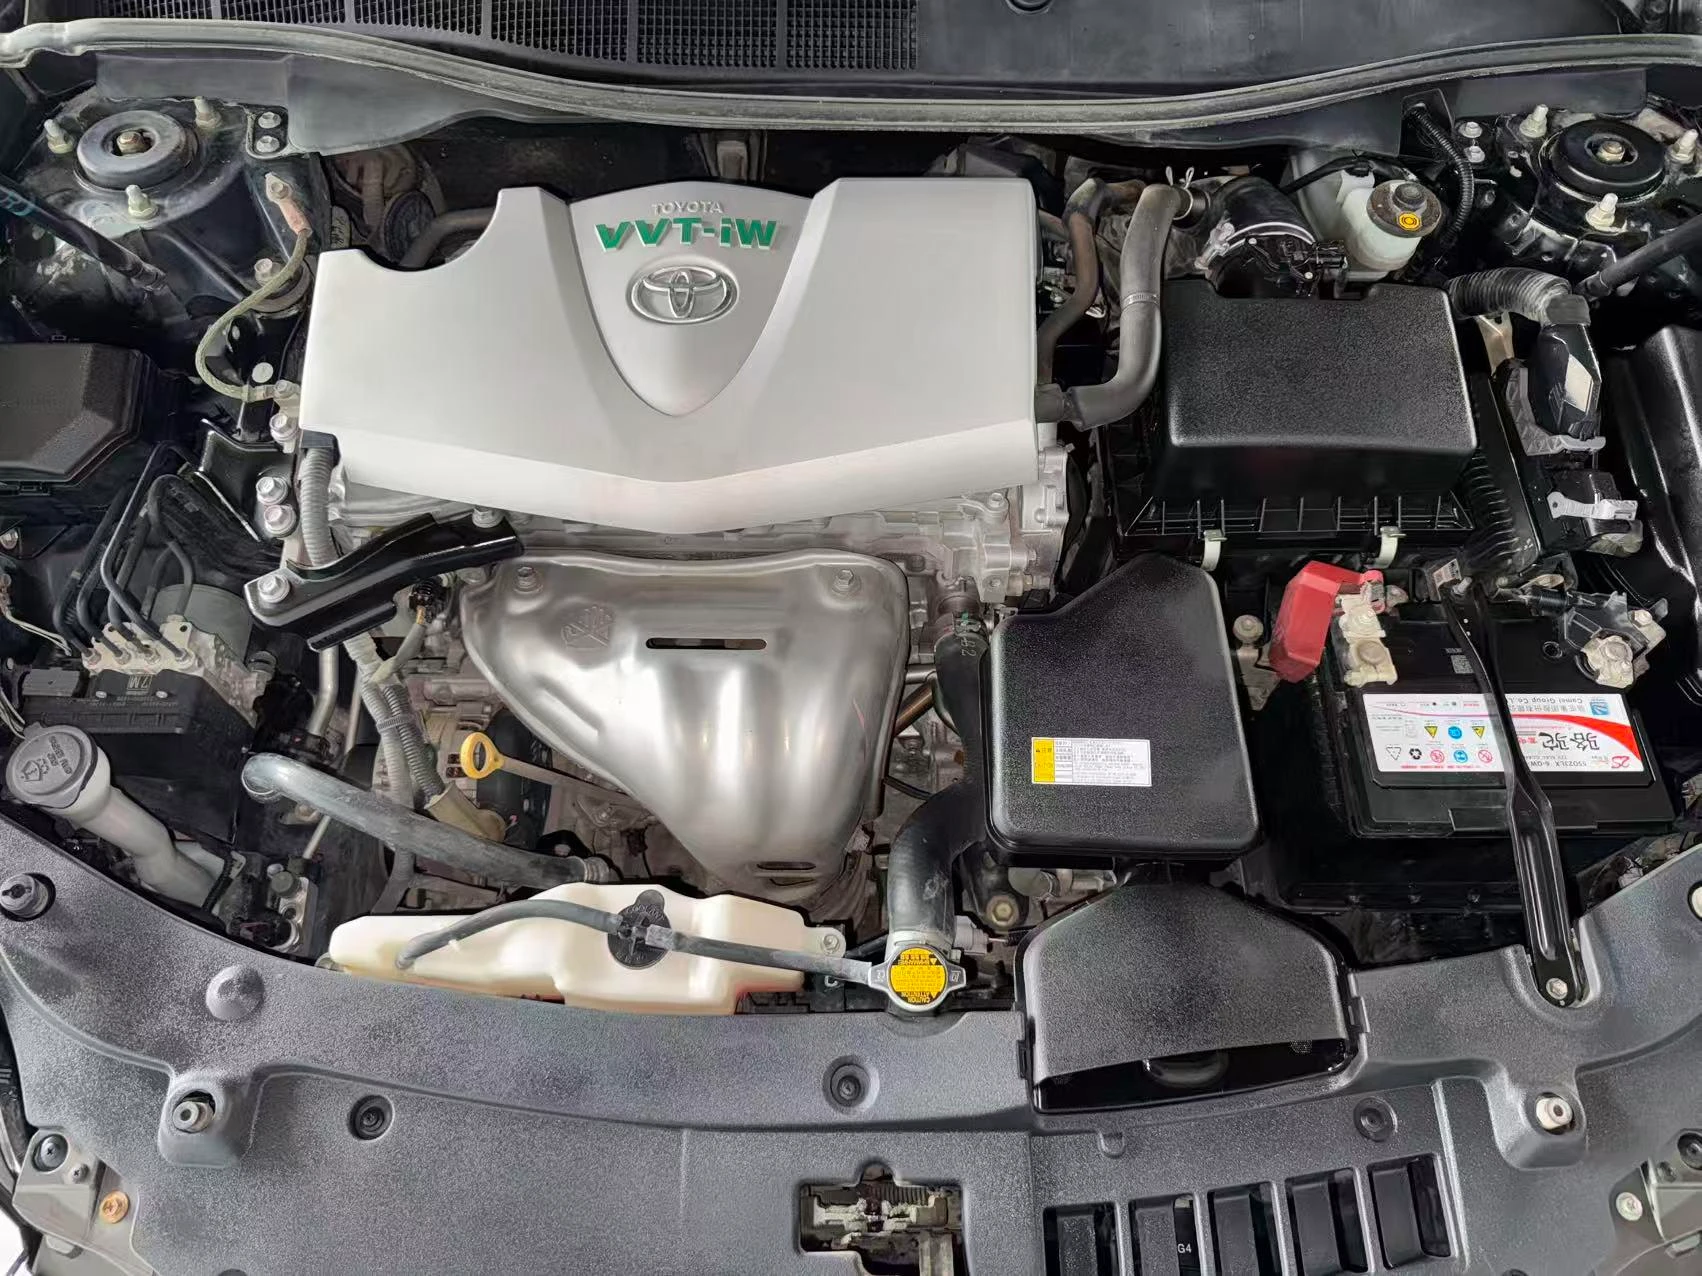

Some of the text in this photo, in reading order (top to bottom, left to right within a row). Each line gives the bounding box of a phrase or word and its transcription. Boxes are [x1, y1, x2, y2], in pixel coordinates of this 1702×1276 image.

[652, 200, 723, 215] TOYOTA
[595, 217, 778, 251] VVT-iW
[1538, 732, 1600, 751] 骆驼
[907, 996, 931, 1004] CAUTION
[1177, 1243, 1192, 1254] G4
